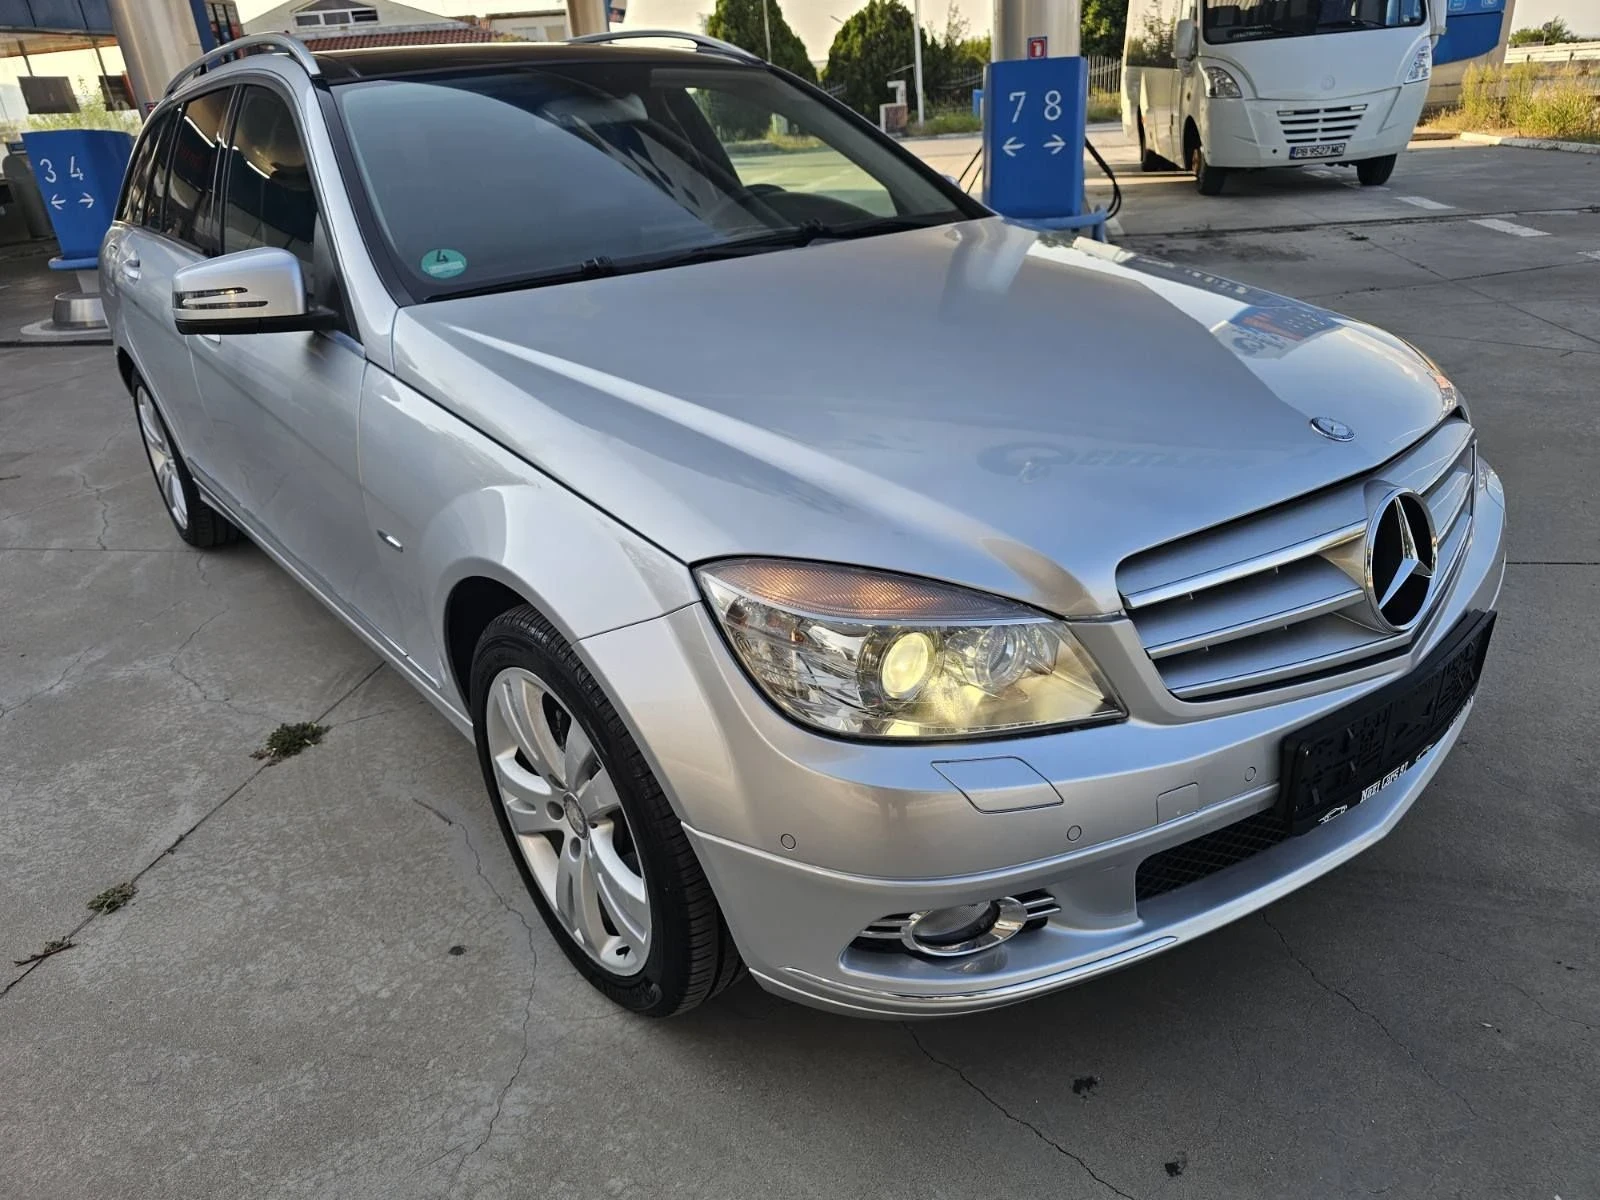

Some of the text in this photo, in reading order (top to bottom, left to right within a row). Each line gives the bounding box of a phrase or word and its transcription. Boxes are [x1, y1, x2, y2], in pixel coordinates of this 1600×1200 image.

[1009, 90, 1062, 123] 7 8
[40, 156, 84, 183] 3 4
[436, 250, 449, 262] 4
